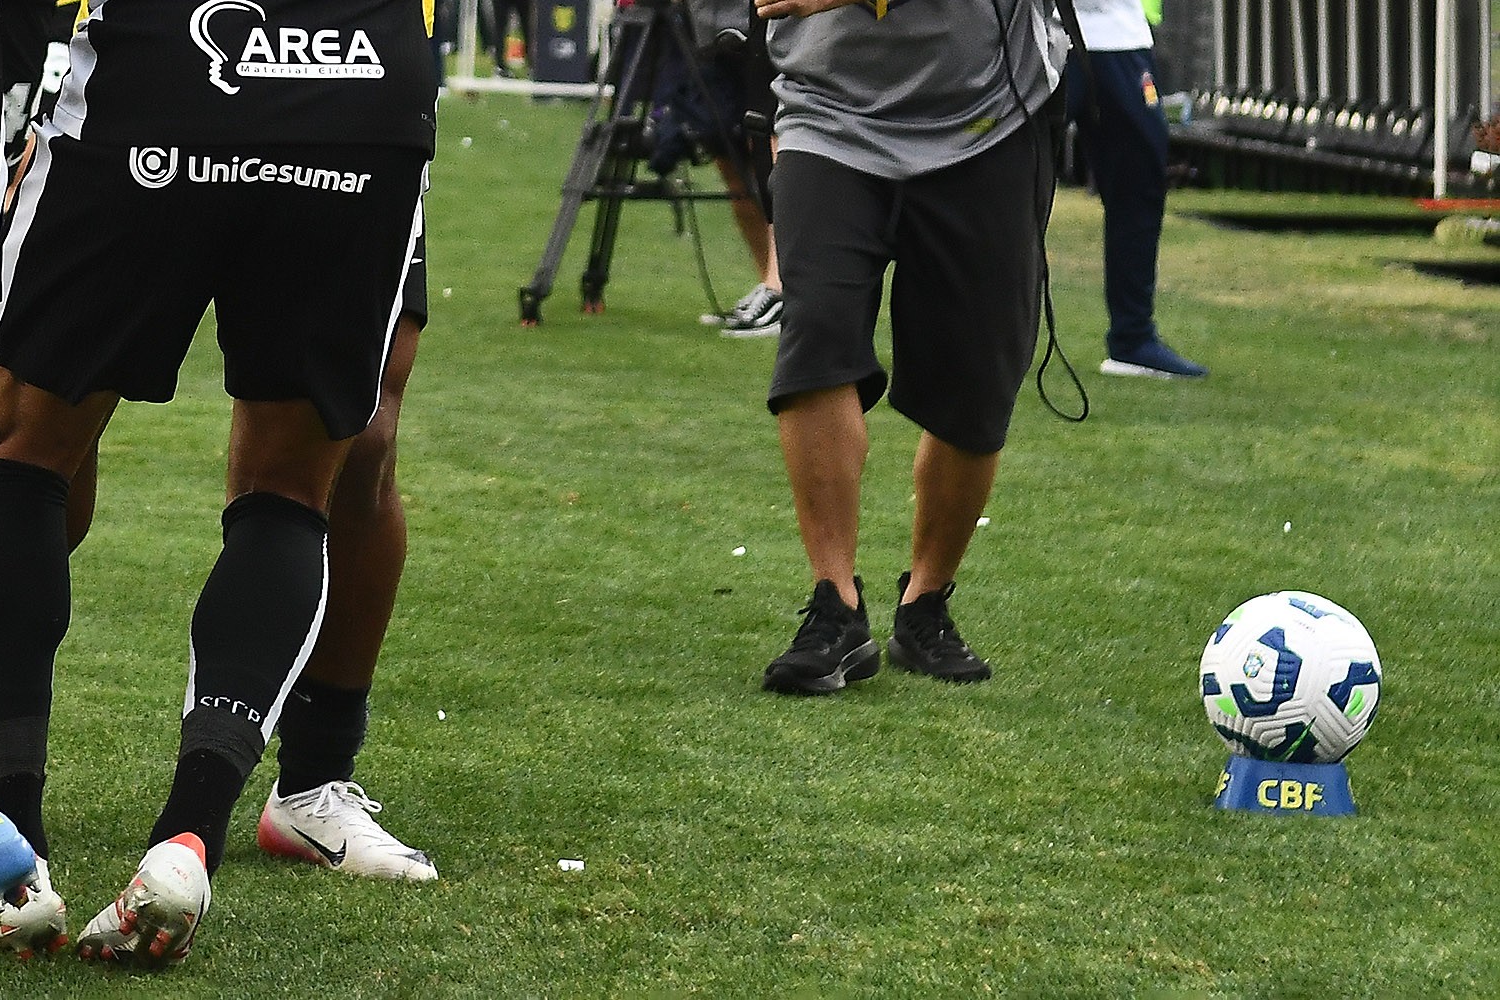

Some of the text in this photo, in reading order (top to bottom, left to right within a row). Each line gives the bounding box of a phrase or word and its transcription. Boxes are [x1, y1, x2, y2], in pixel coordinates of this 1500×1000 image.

[240, 28, 381, 64] AREA
[188, 155, 372, 194] UniCesumar
[1257, 778, 1324, 811] CBF
